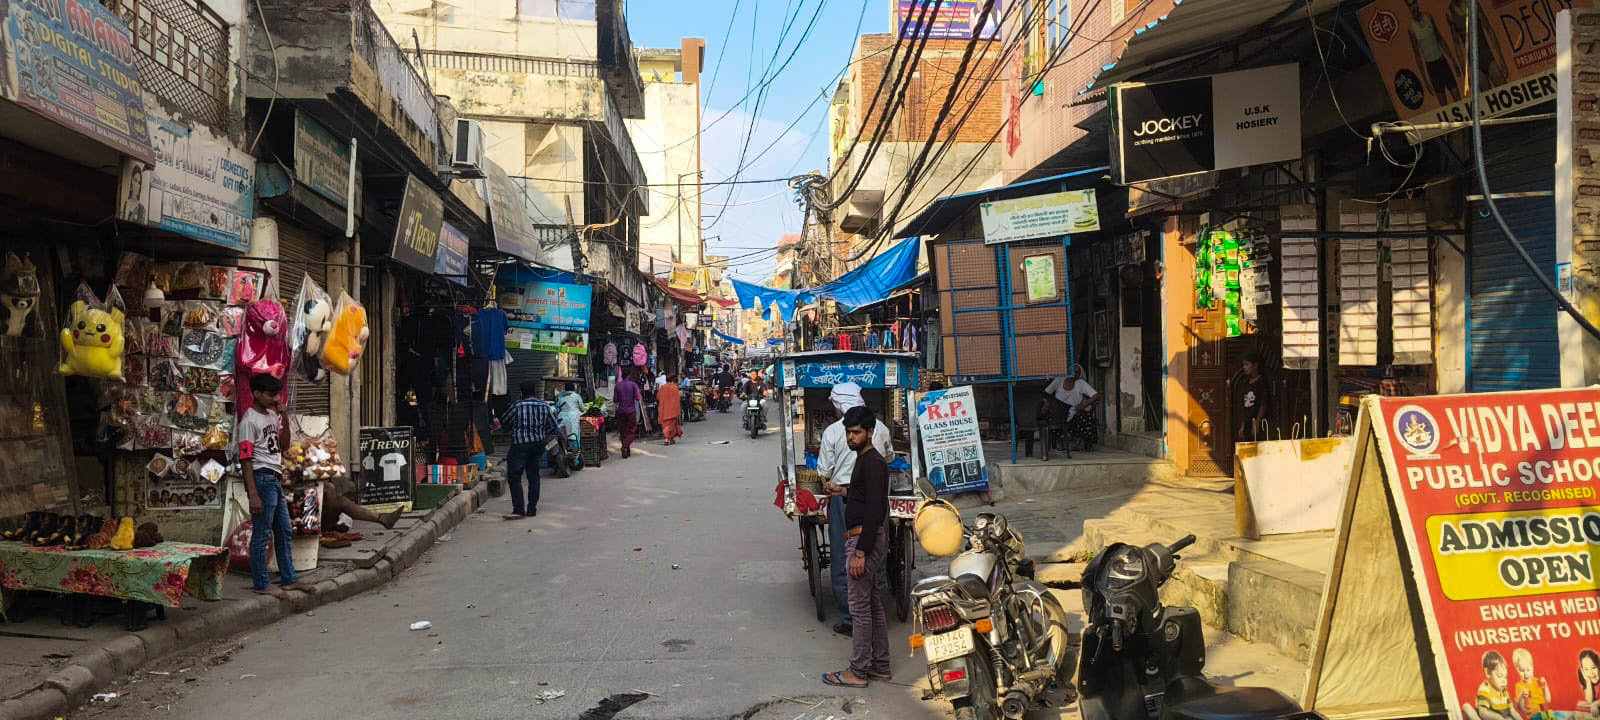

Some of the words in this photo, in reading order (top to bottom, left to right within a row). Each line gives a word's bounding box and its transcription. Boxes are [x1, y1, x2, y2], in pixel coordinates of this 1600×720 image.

[64, 0, 134, 66] ANAND
[39, 22, 96, 72] DIGITAL
[97, 59, 140, 97] STUDIO
[1515, 46, 1548, 66] PREMIUM
[1244, 105, 1270, 117] U.S.K
[1133, 113, 1203, 137] JOCKEY
[1236, 117, 1278, 131] HOSIERY
[927, 400, 968, 420] R.P.
[923, 421, 947, 431] GLASS
[949, 417, 973, 427] HOUSE
[1445, 406, 1541, 454] VIDYA
[1540, 402, 1600, 450] DEE
[360, 439, 410, 451] #TREND
[1406, 461, 1511, 490] PUBLIC
[1455, 492, 1502, 508] (GOVT.
[1504, 486, 1597, 503] RECOGNISED)
[1499, 553, 1593, 587] OPEN
[1480, 602, 1556, 621] ENGLISH
[1454, 625, 1542, 651] (NURSERY
[1547, 623, 1571, 637] TO
